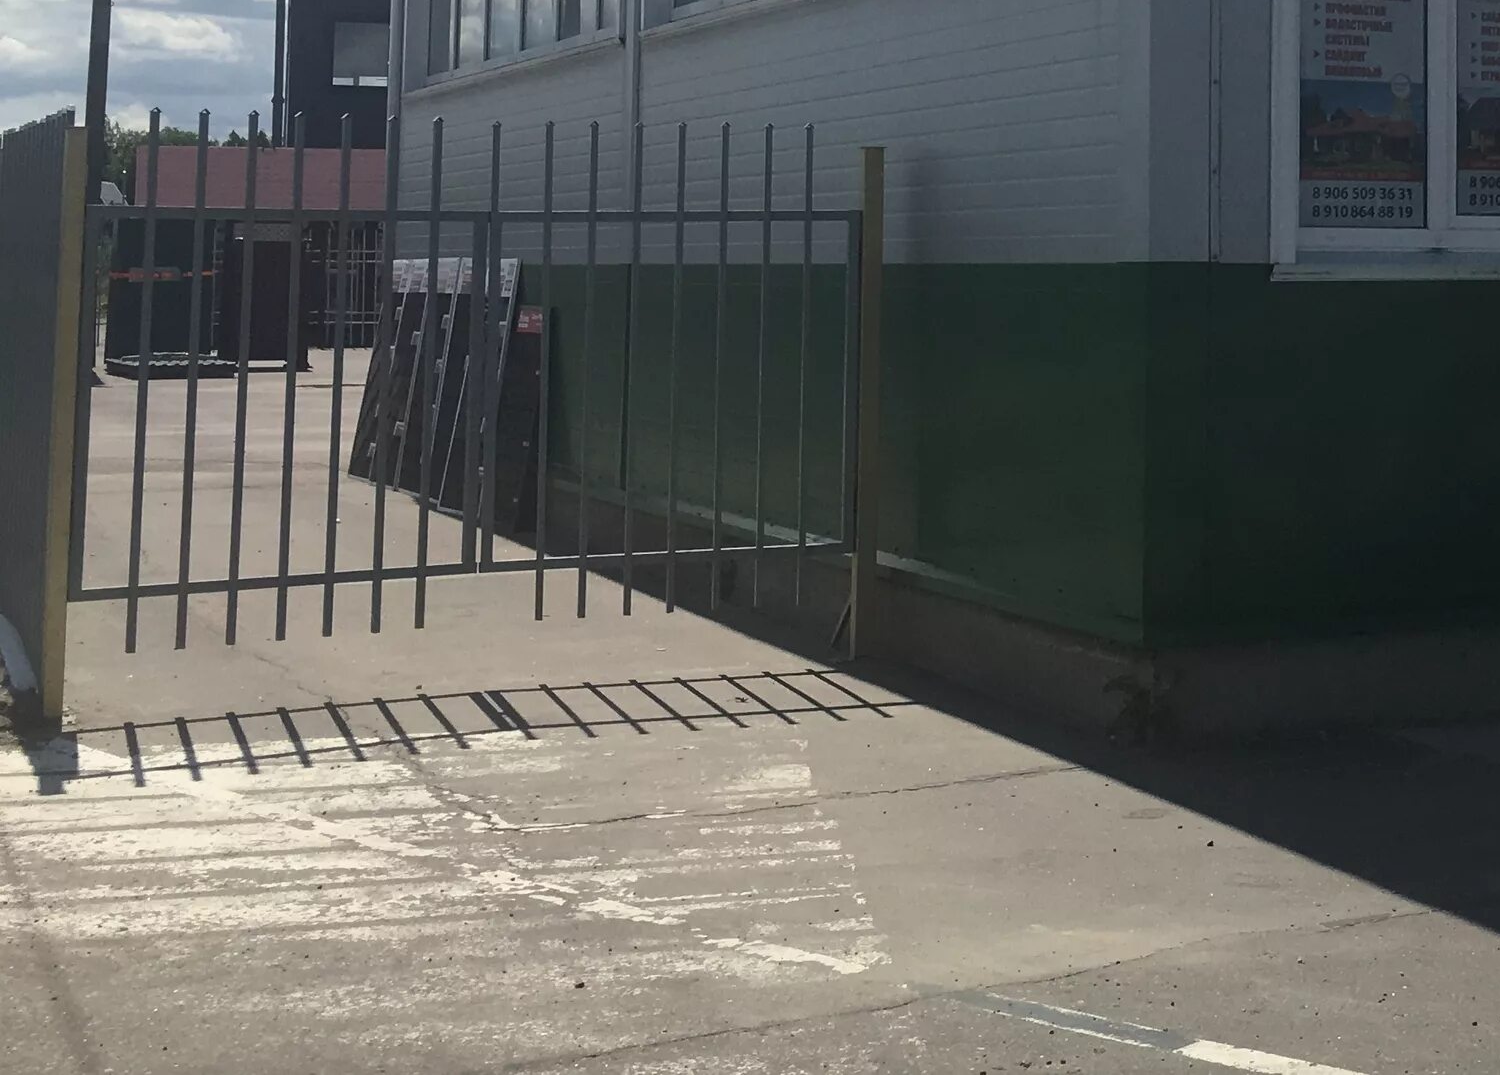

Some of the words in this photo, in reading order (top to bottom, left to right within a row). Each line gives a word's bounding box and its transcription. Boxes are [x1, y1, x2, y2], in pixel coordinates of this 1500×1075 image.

[1312, 187, 1320, 199] 8
[1324, 187, 1348, 199] 906
[1352, 187, 1376, 199] 509
[1379, 187, 1395, 199] 36
[1312, 205, 1320, 218] 8
[1324, 205, 1348, 218] 910
[1350, 205, 1375, 218] 864
